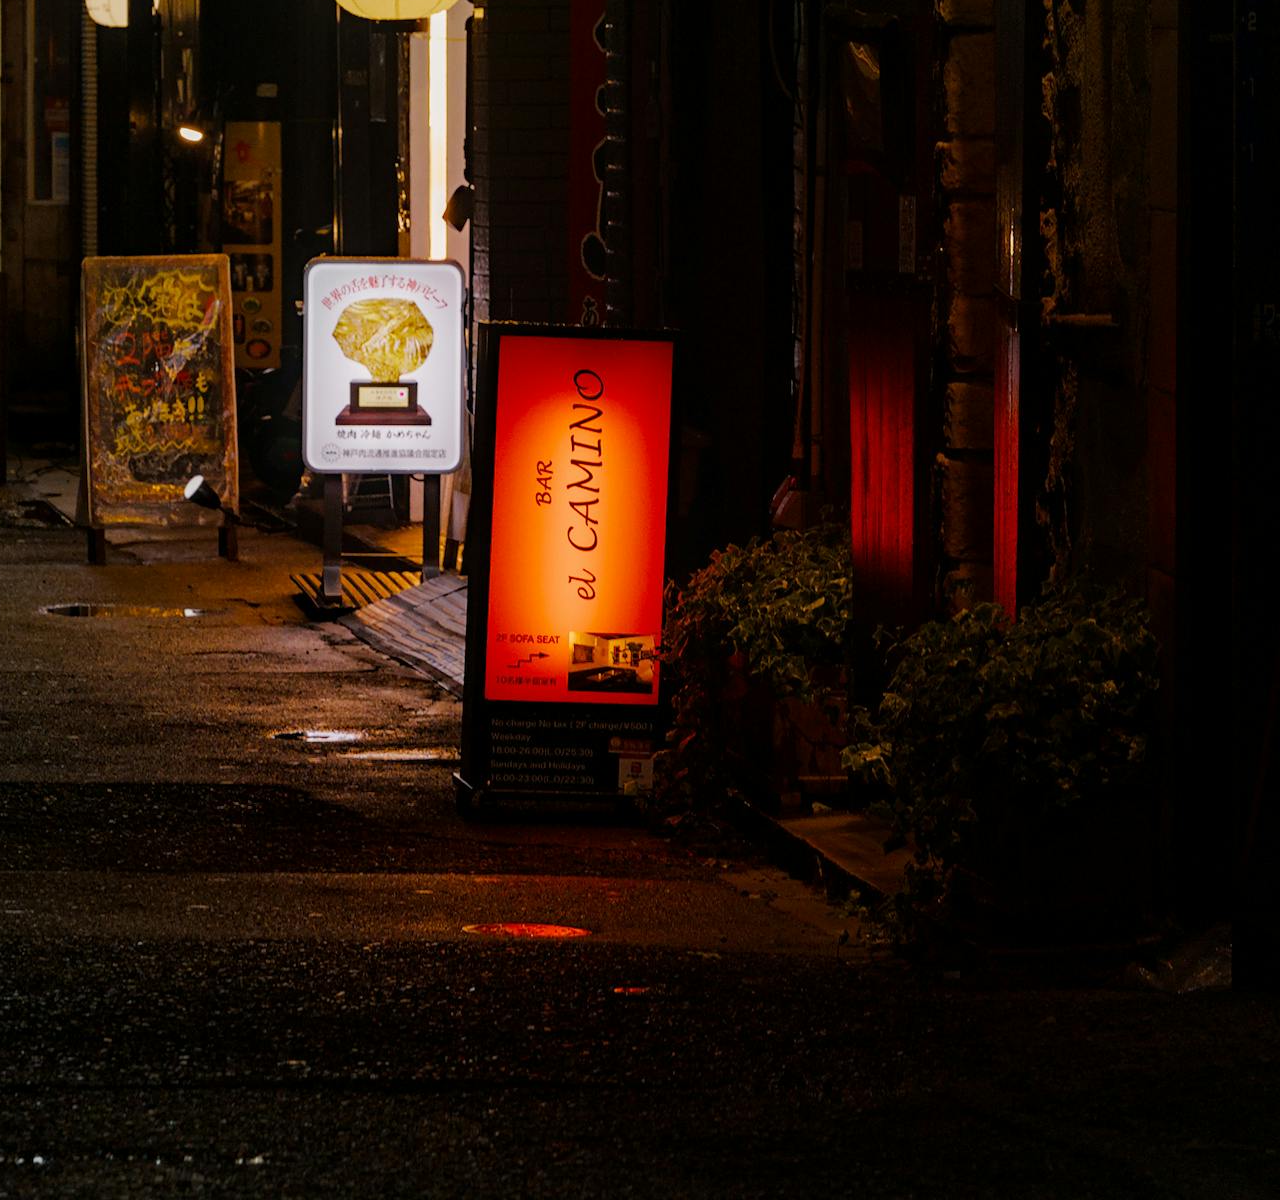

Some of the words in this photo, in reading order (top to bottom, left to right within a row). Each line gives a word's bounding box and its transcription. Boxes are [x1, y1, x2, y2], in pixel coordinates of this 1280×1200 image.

[567, 368, 605, 552] CAMINO
[535, 459, 553, 506] BAR
[568, 568, 596, 601] el
[509, 633, 535, 644] SOFA
[536, 634, 561, 644] SEAT
